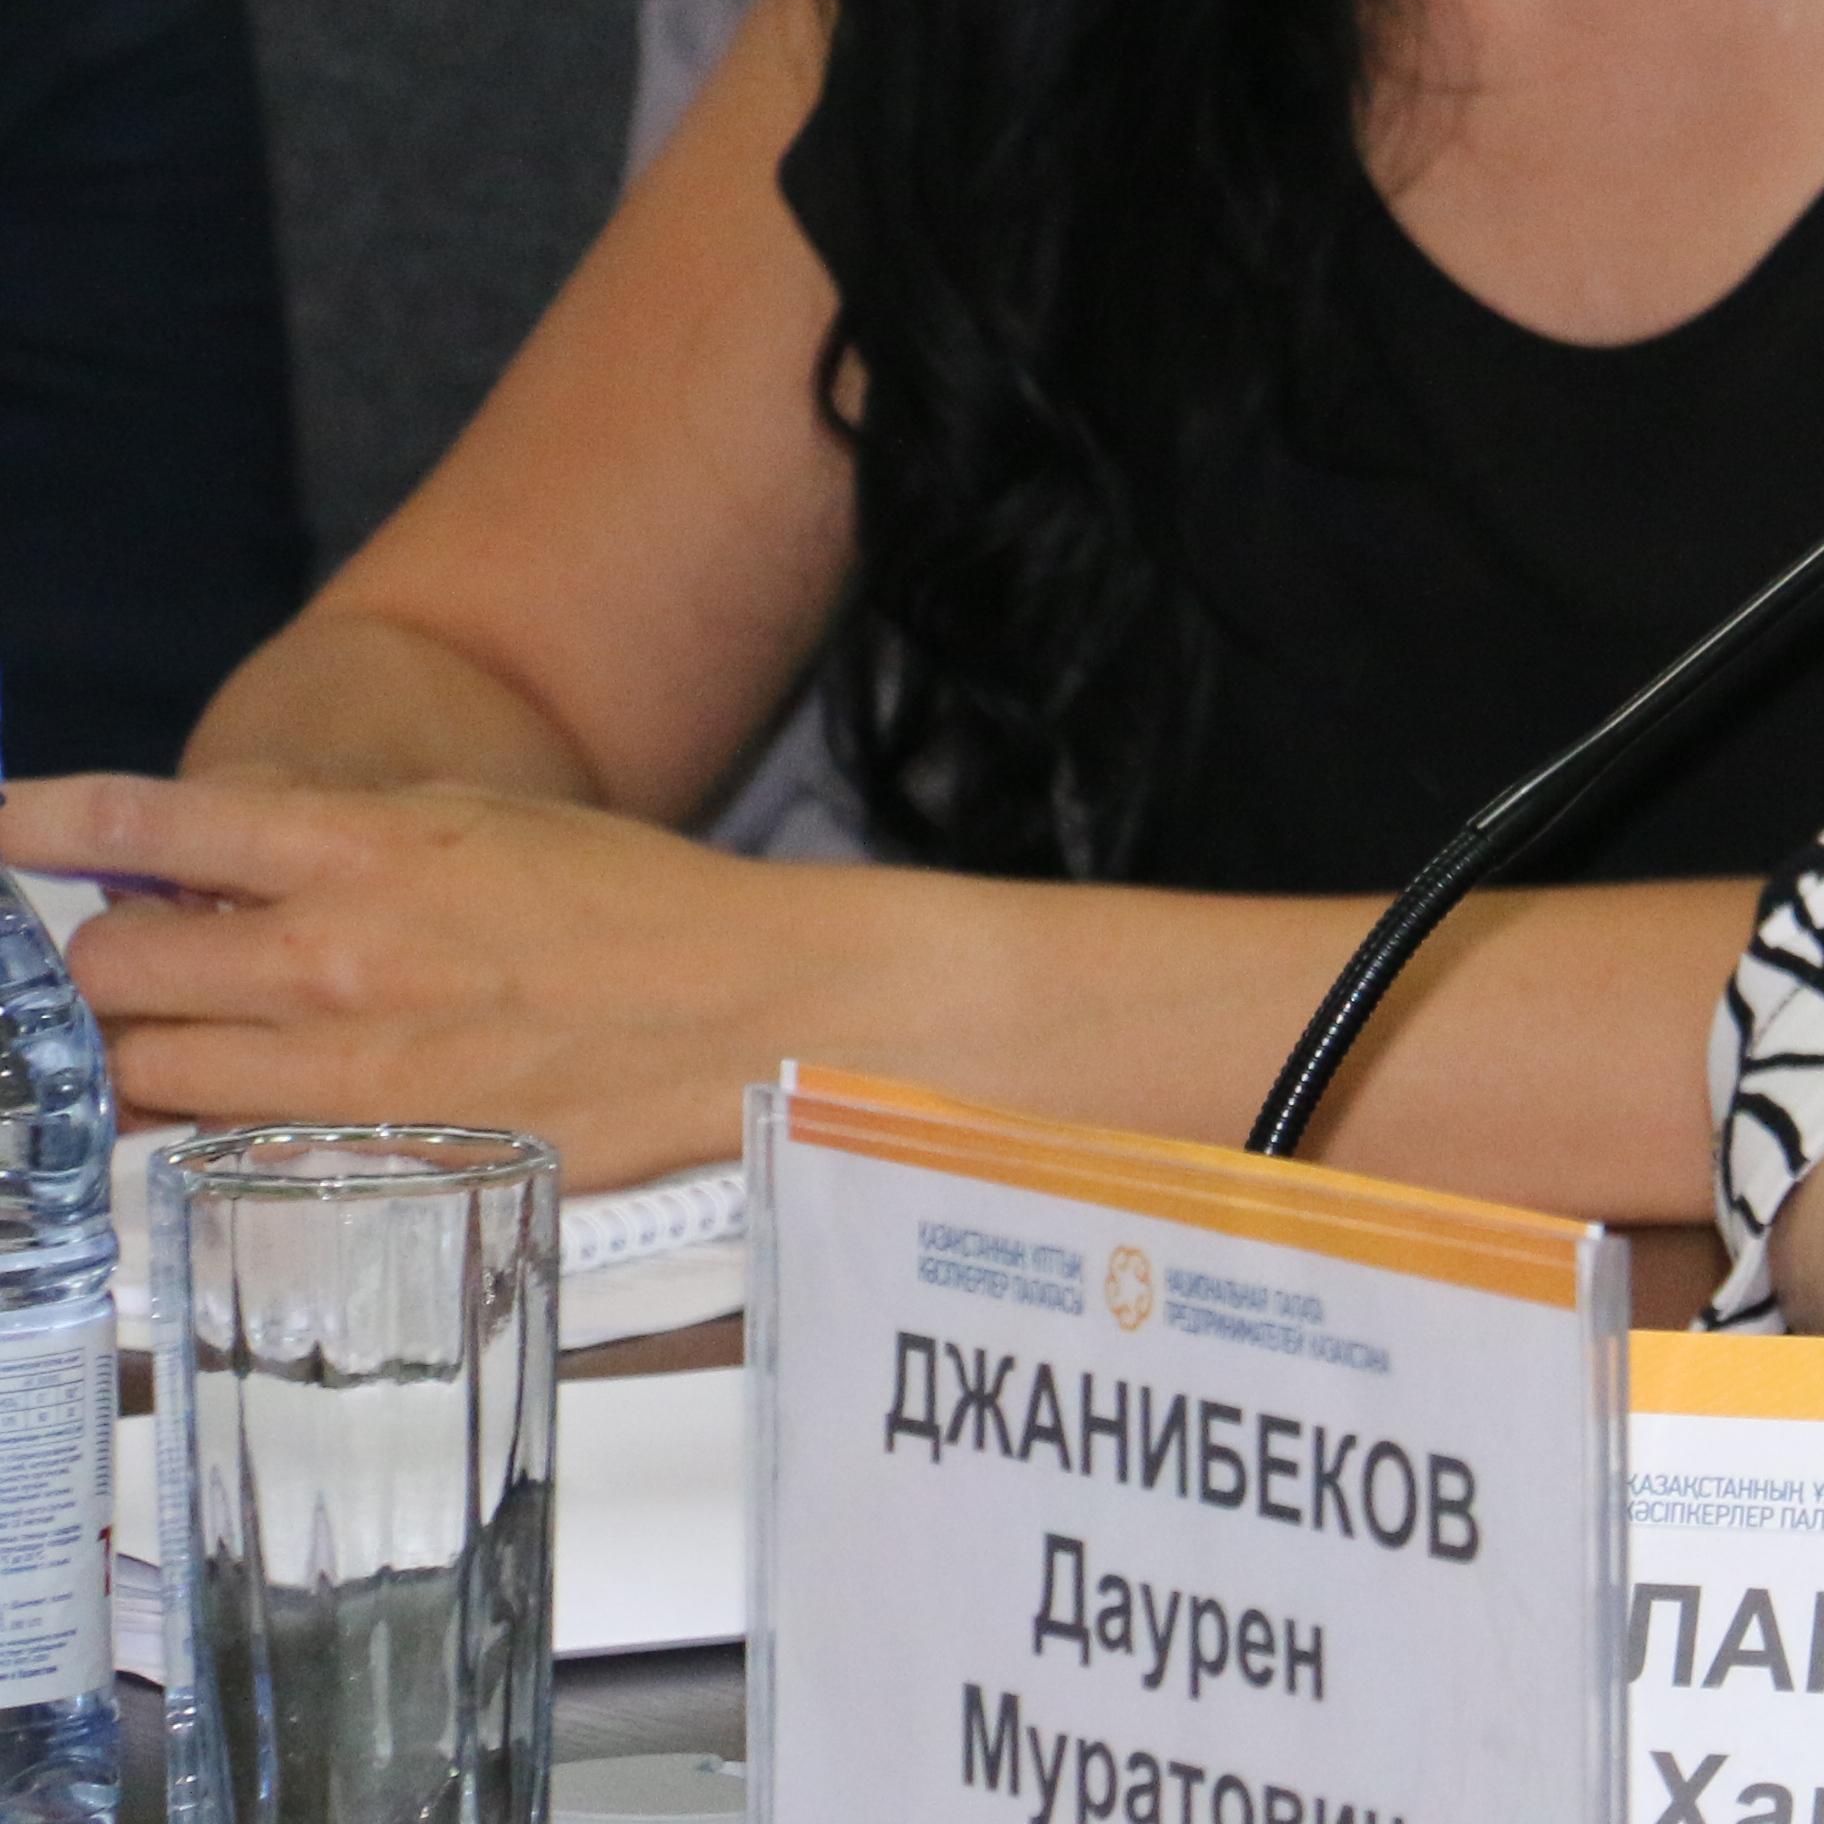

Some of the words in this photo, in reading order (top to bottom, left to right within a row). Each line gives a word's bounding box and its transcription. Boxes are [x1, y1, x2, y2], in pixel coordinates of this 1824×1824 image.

[884, 1330, 1481, 1564] ДЖАНИБЕКОВ
[1032, 1532, 1324, 1701] Даурен
[963, 1682, 1404, 1824] Муратов
